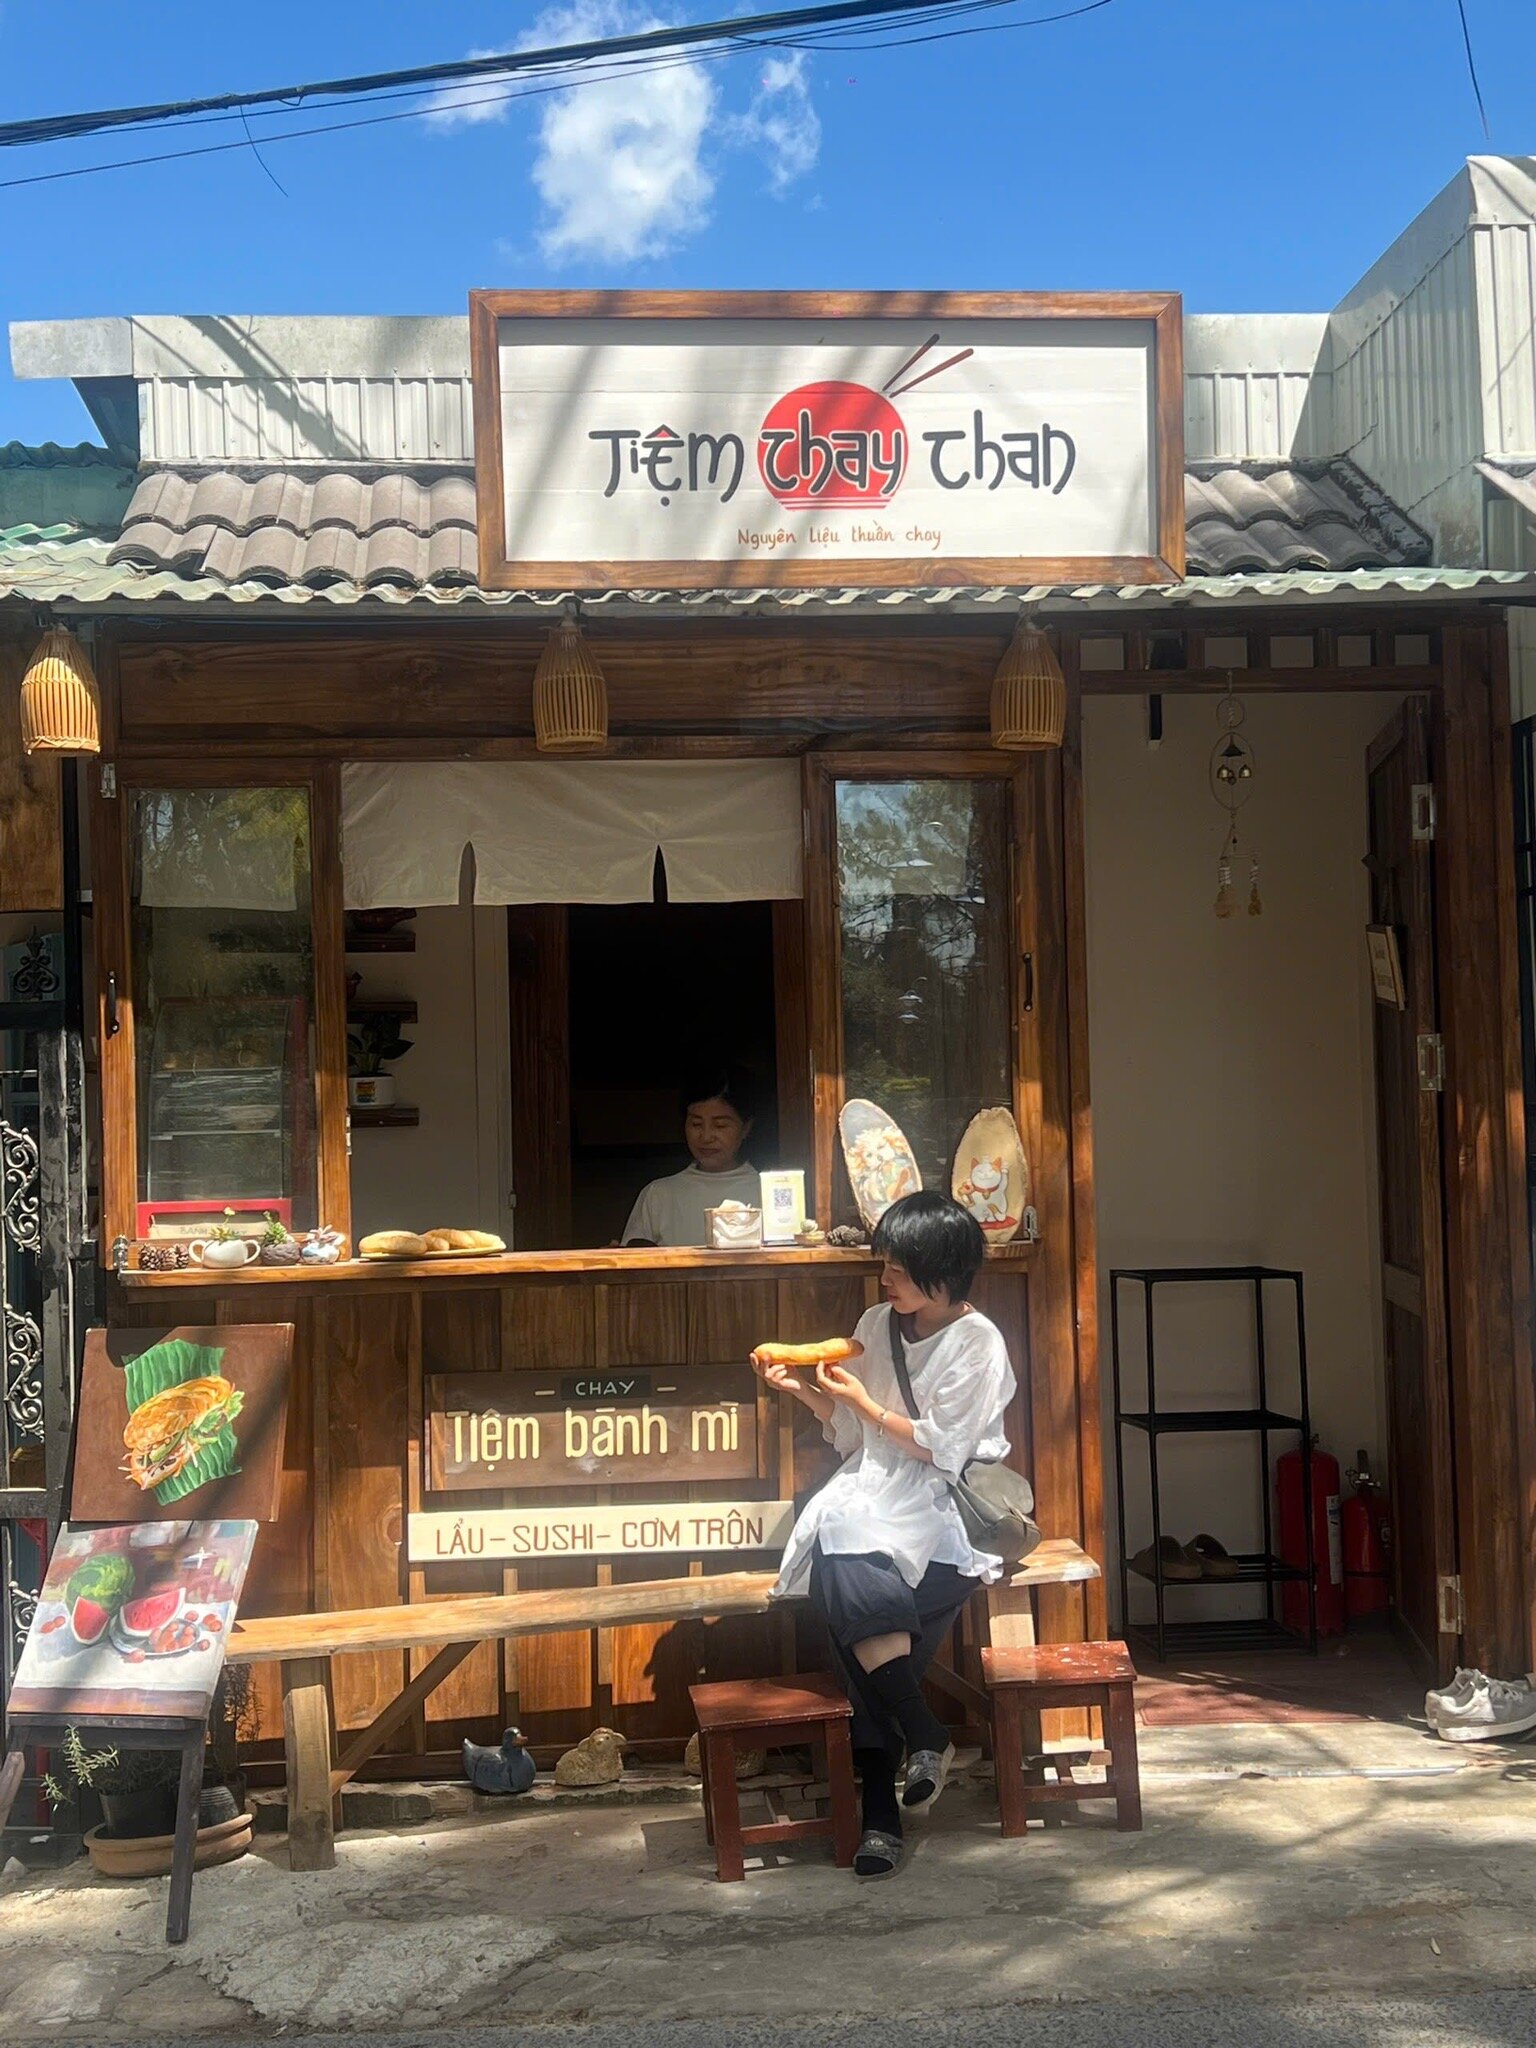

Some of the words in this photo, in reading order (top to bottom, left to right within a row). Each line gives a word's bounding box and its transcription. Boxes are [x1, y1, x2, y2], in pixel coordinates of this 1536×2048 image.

[738, 528, 797, 550] Nguyên
[851, 520, 895, 543] thuần
[905, 525, 941, 550] chay
[575, 1380, 635, 1396] CHAY
[446, 1408, 540, 1471] Tiệm
[513, 1523, 593, 1554] SUSHI
